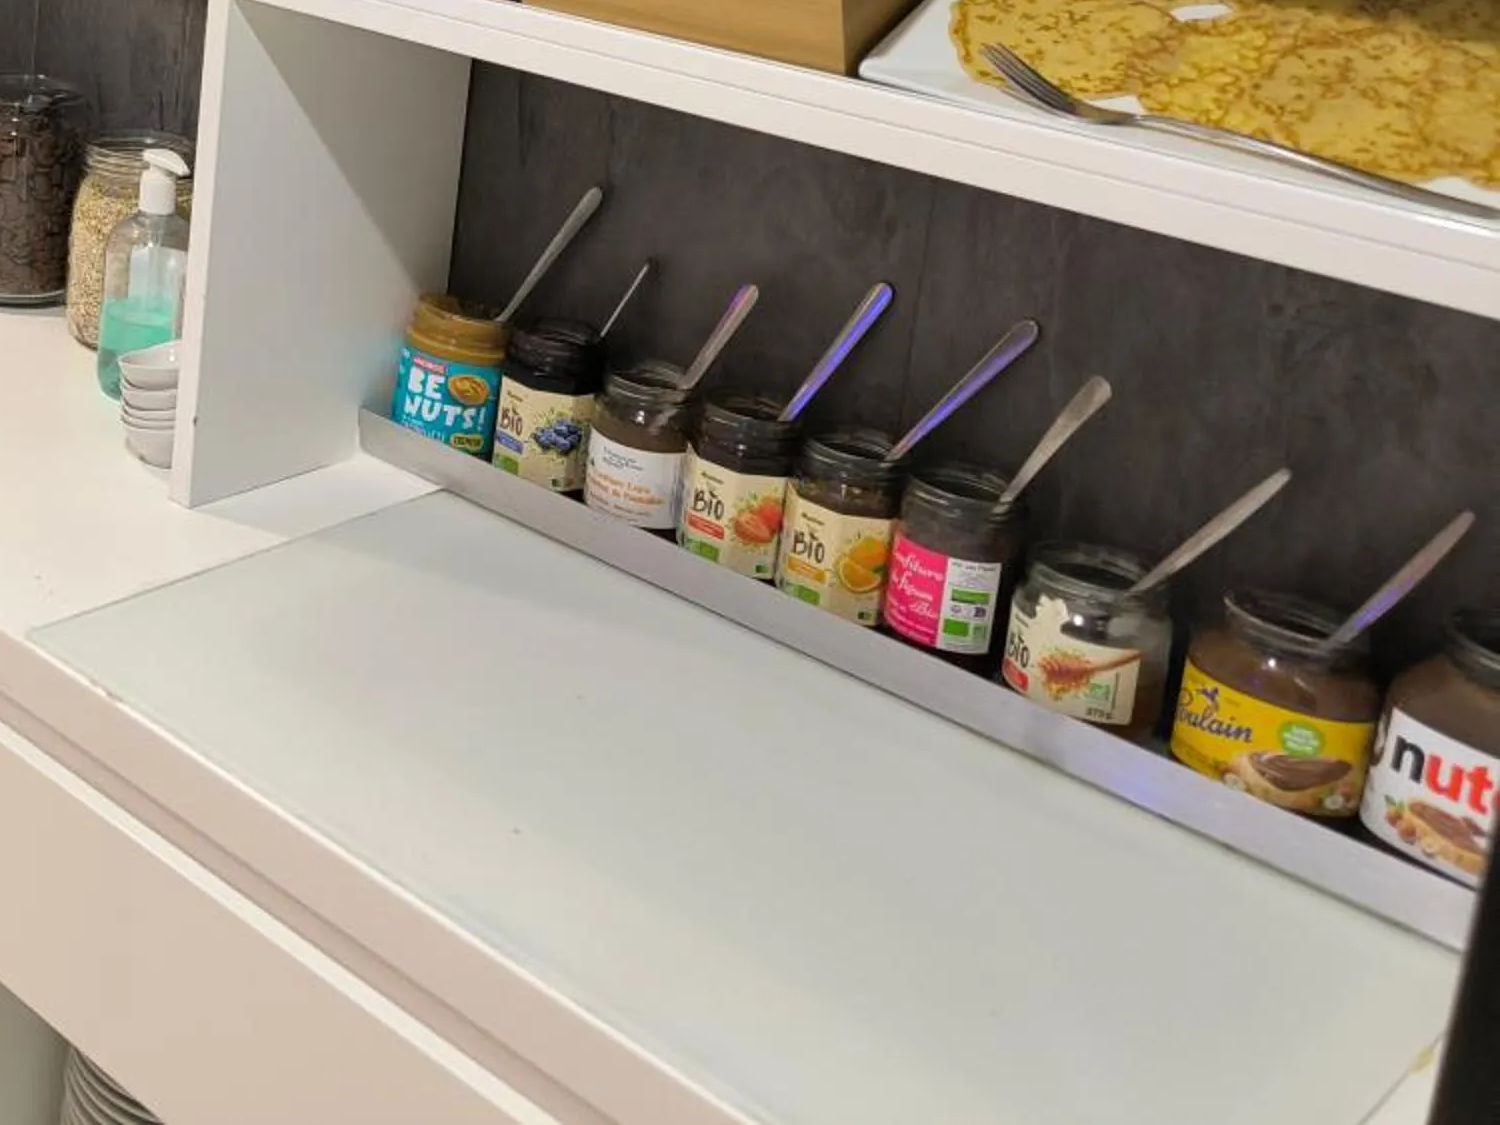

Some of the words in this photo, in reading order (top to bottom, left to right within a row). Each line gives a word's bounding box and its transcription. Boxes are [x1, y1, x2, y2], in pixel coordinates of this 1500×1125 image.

[408, 366, 446, 401] BE
[404, 392, 487, 432] NUTS!
[1390, 734, 1500, 816] nut
